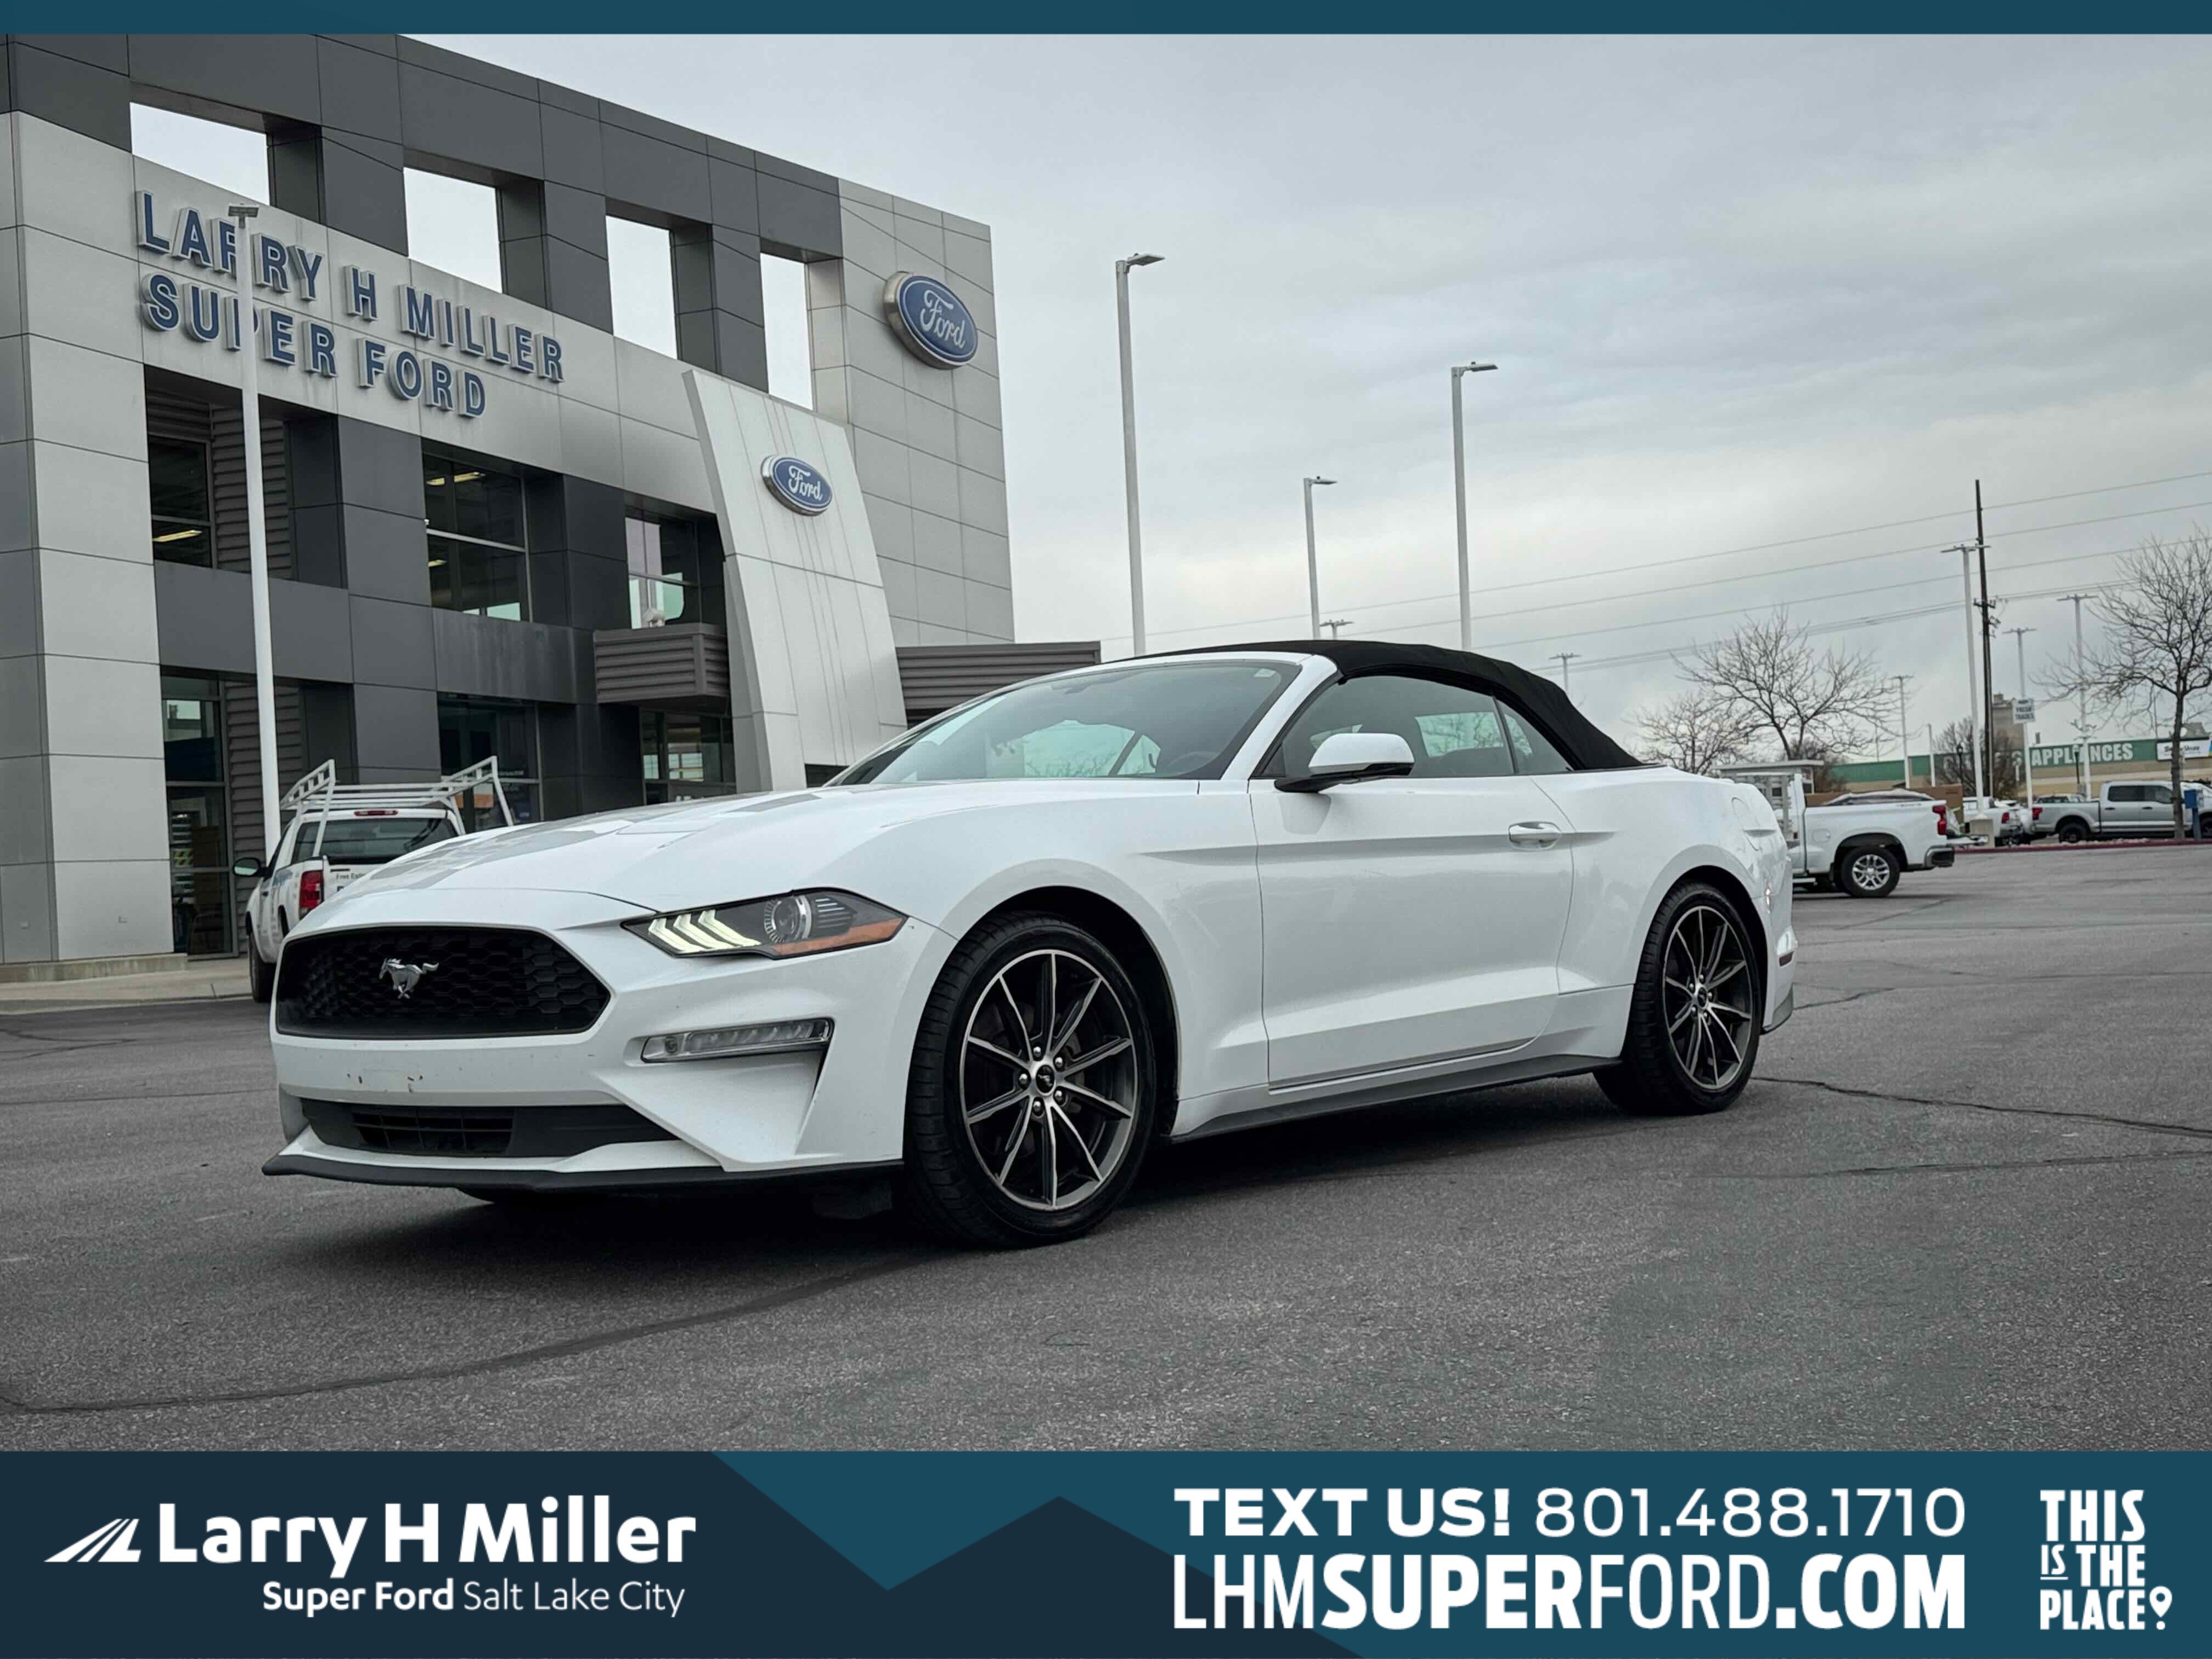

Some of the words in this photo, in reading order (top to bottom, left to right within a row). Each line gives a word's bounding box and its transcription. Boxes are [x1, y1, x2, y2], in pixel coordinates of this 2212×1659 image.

[345, 264, 377, 321] H
[399, 285, 565, 382] MILLER
[919, 289, 966, 349] Ford
[358, 337, 486, 418] FORD
[788, 465, 824, 501] Ford
